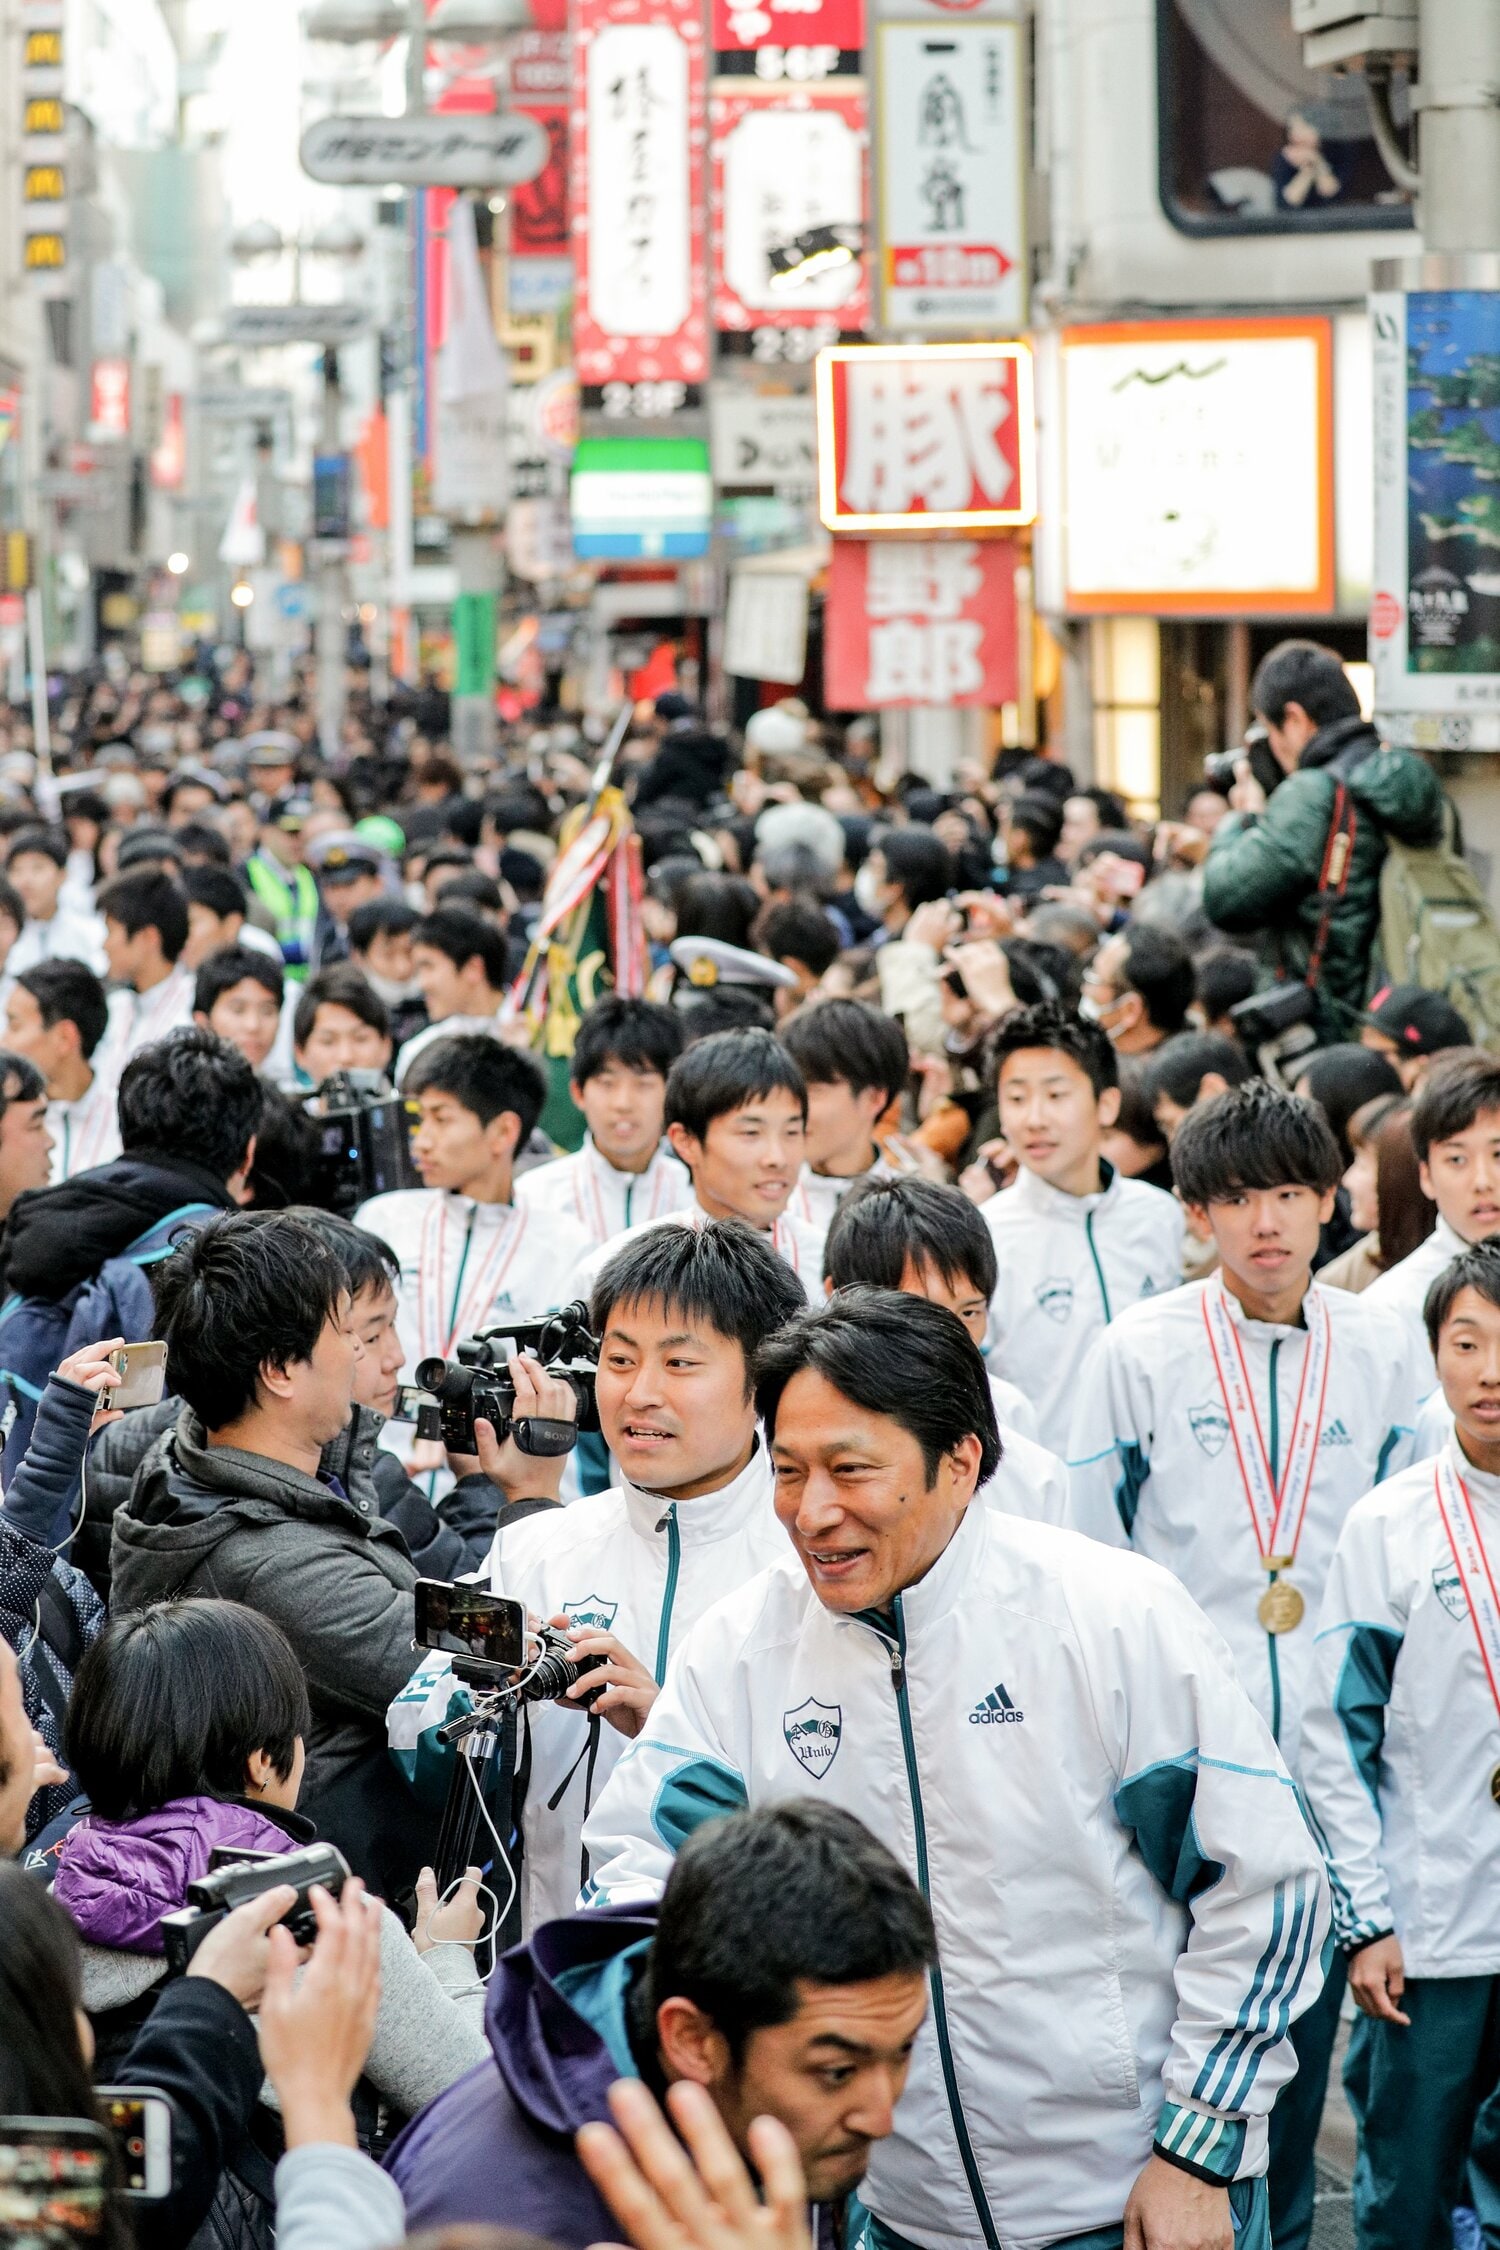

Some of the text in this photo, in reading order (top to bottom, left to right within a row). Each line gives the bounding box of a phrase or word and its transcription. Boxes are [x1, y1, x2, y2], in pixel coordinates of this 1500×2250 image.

[918, 42, 985, 232] 一風堂
[840, 359, 1013, 513] 豚
[865, 541, 984, 702] 野郎
[544, 1430, 572, 1441] SONY
[969, 1708, 1024, 1724] adidas
